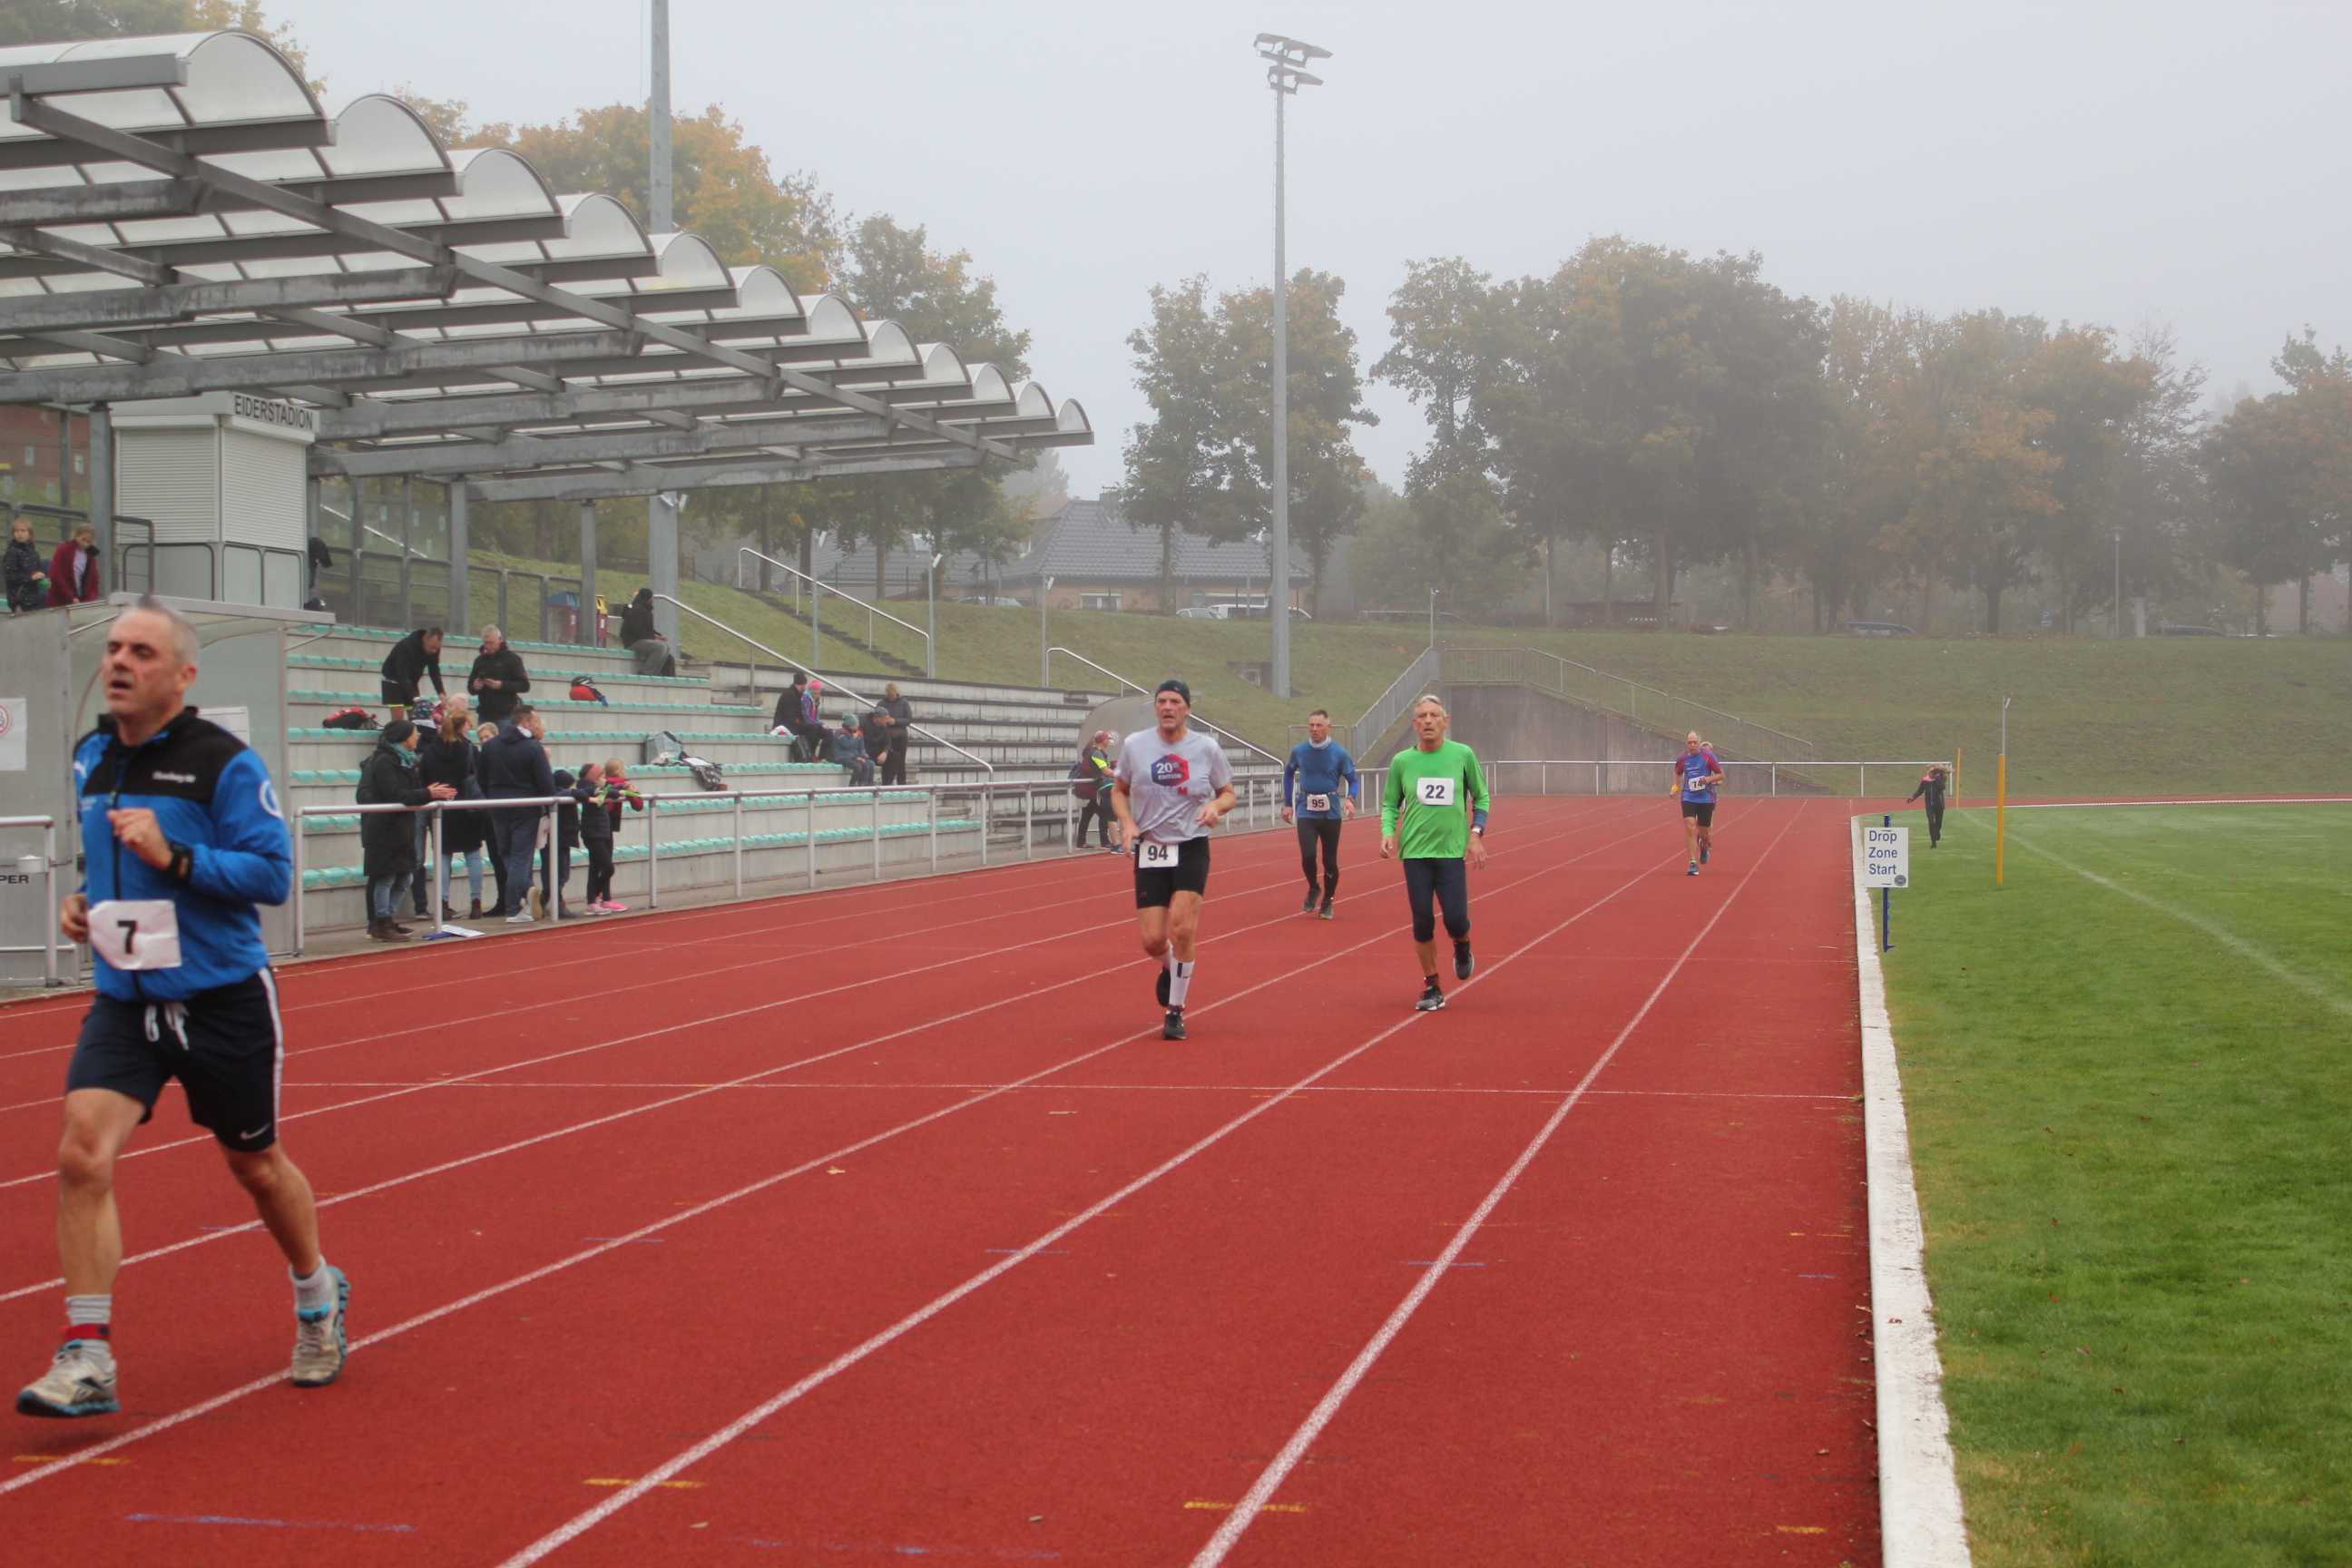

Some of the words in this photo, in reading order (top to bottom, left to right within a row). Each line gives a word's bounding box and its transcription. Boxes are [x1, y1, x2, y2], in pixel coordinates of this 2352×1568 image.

[234, 395, 313, 429] EIDERSTADION
[1425, 784, 1445, 799] 22
[1311, 799, 1325, 808] 95
[1869, 830, 1897, 844] Drop
[1148, 845, 1168, 861] 94
[1868, 847, 1898, 858] Zone
[1869, 863, 1896, 875] Start
[116, 920, 137, 956] 7
